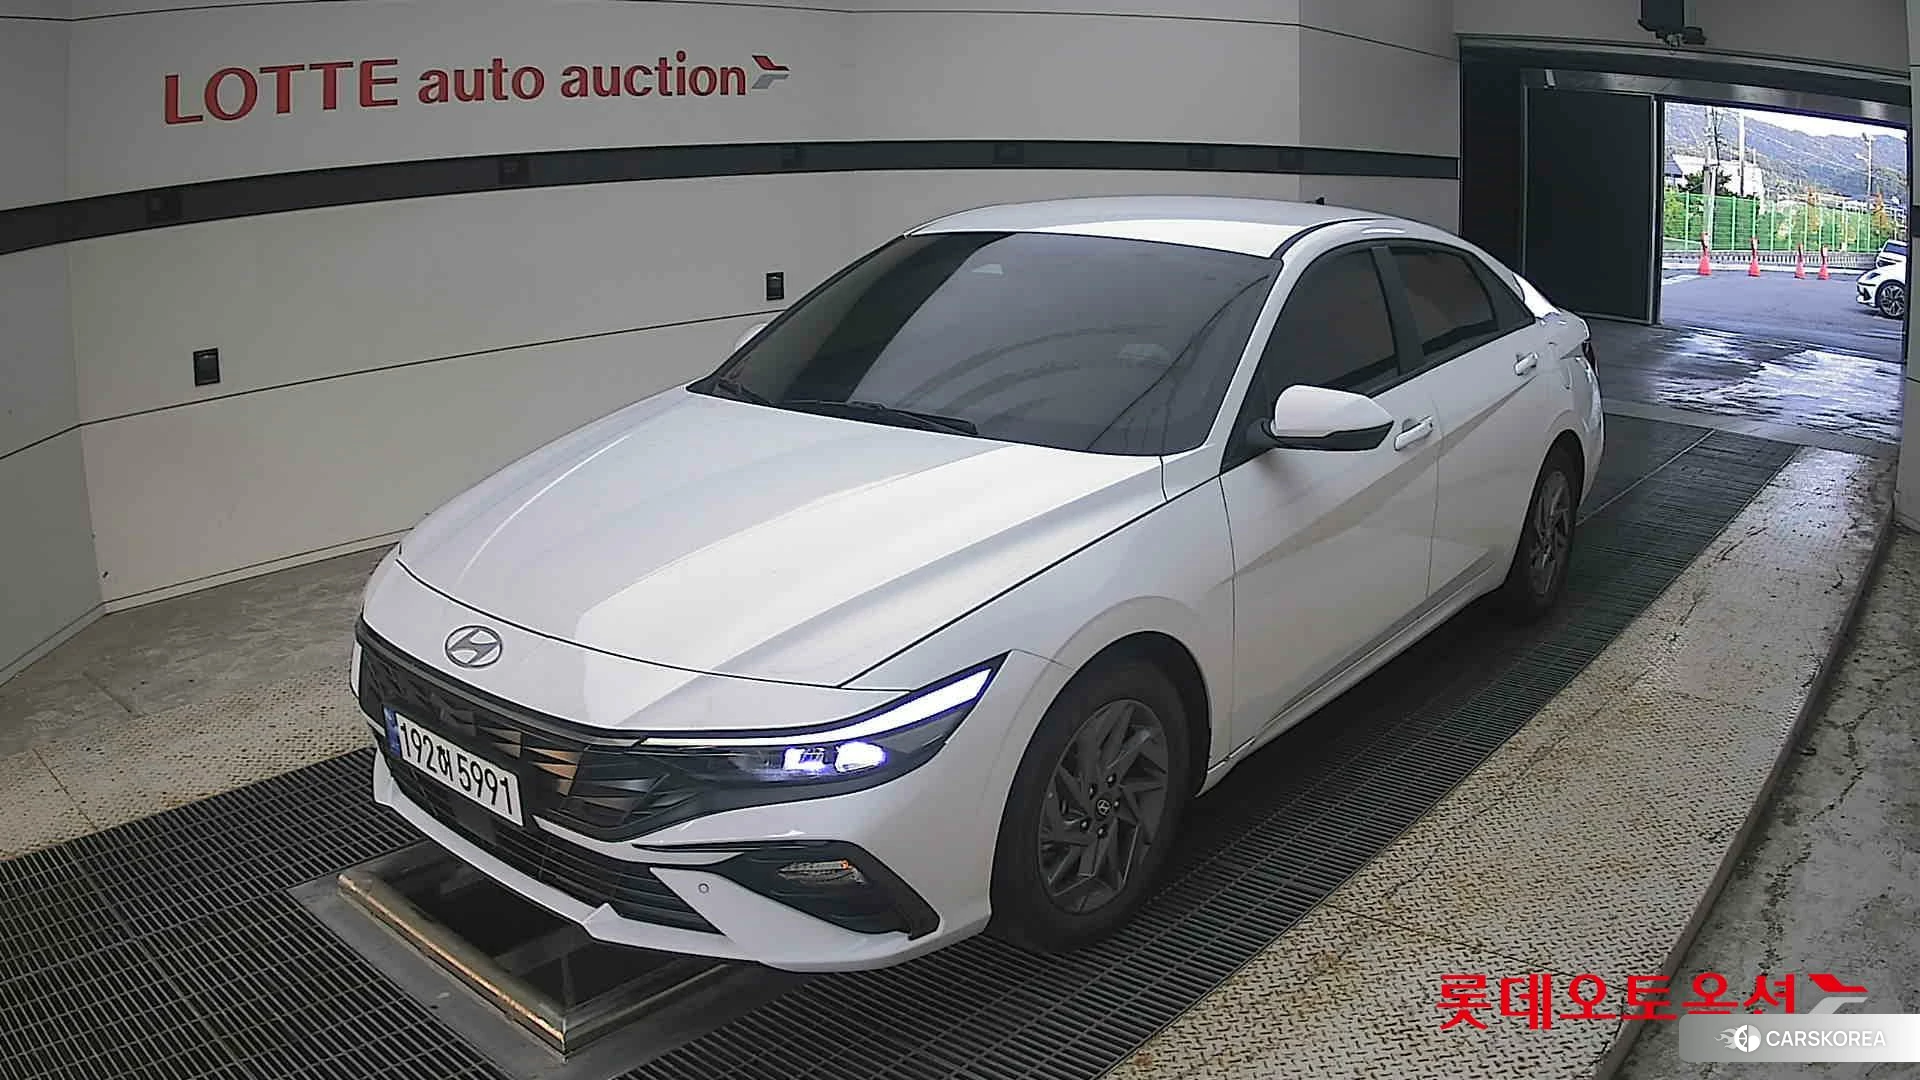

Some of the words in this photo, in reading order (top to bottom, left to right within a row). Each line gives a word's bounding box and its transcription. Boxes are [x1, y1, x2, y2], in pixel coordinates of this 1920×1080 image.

[164, 58, 399, 125] LOTTE
[418, 57, 546, 104] auto
[560, 50, 748, 98] auction
[456, 752, 513, 815] 5991
